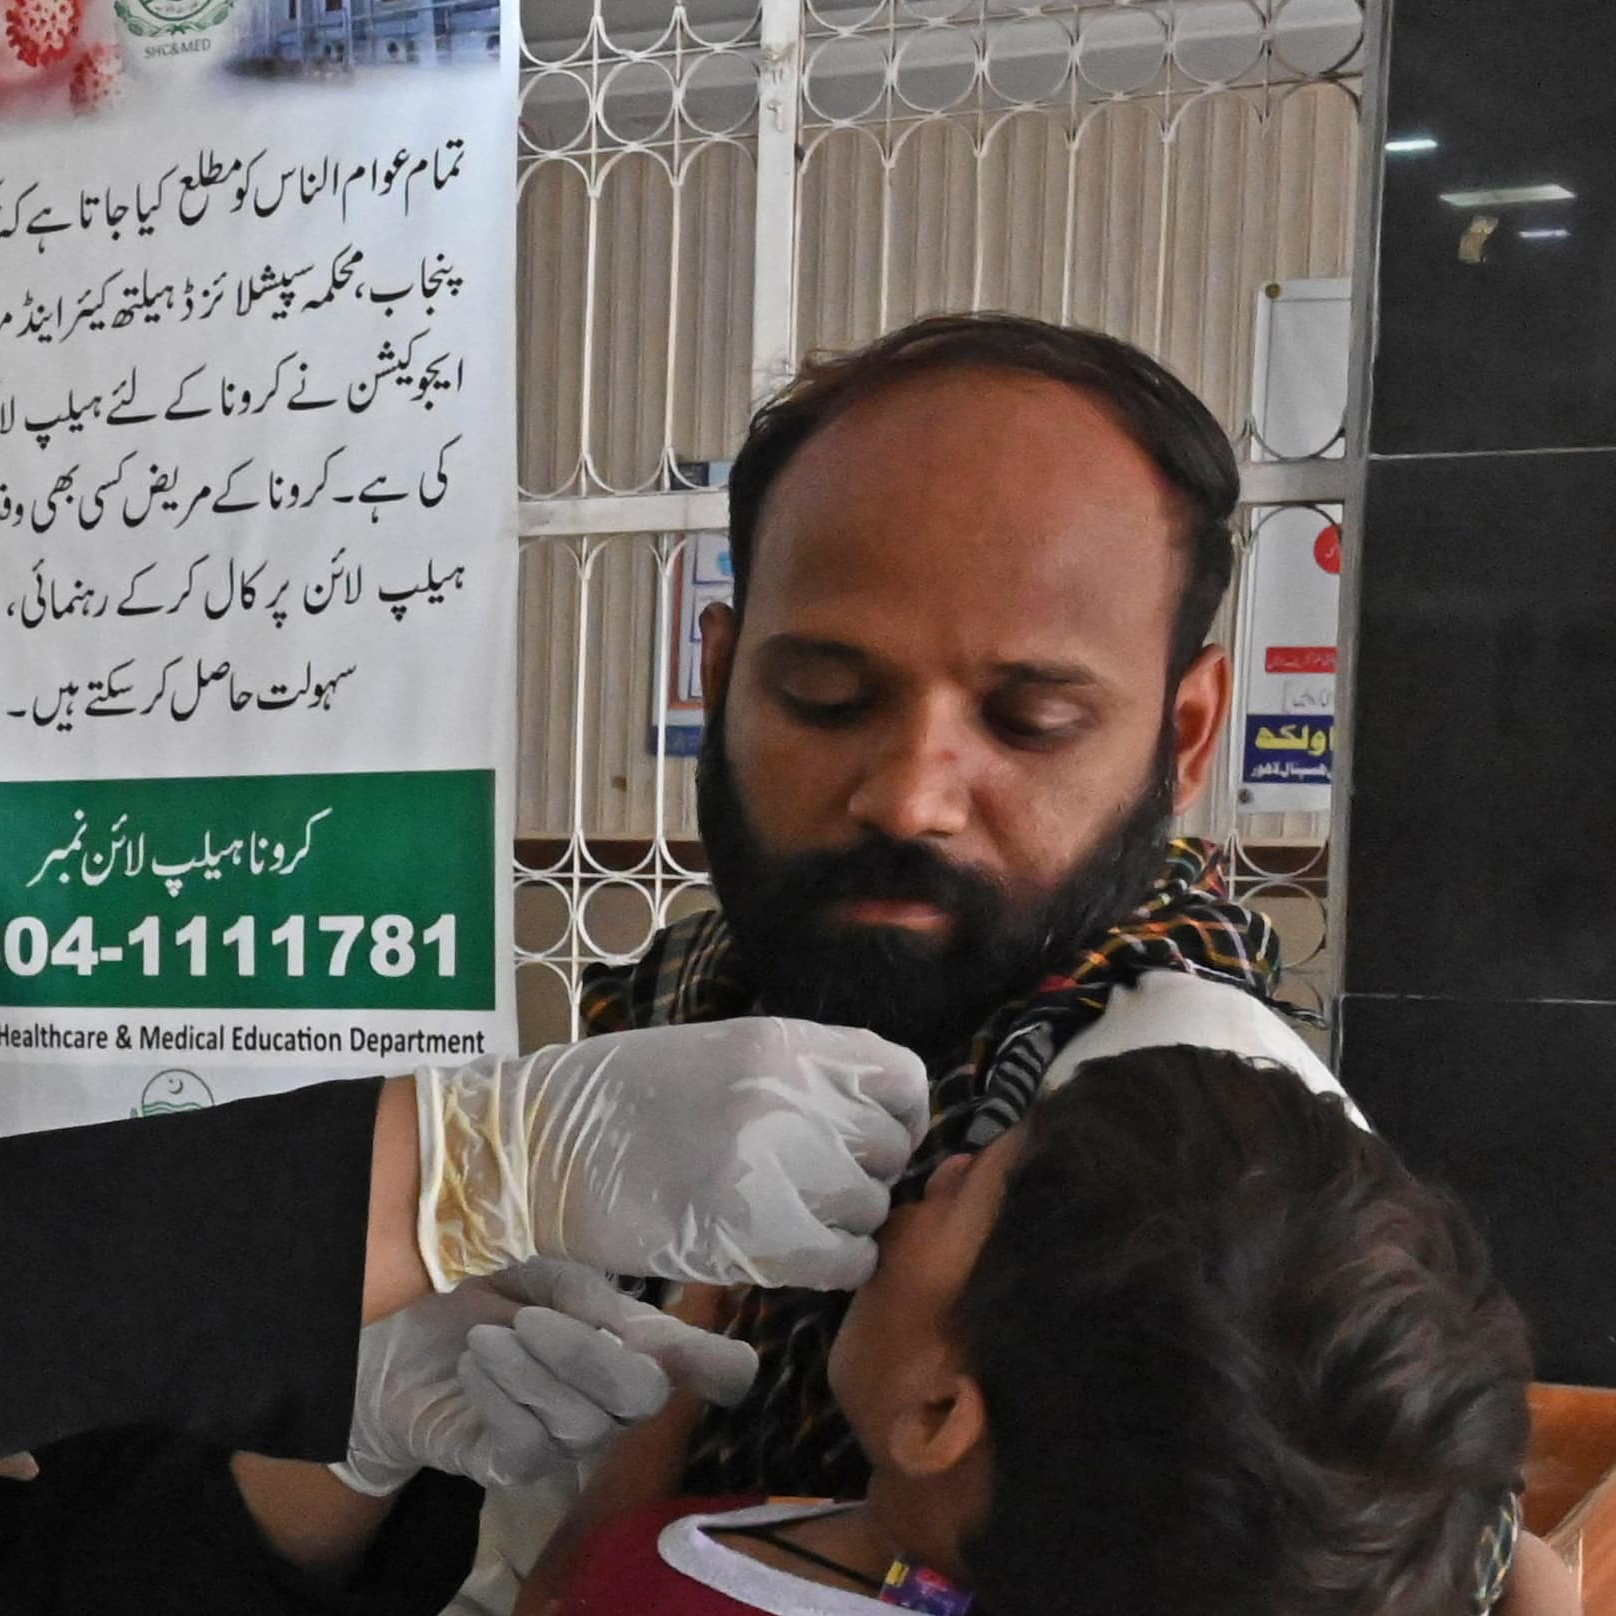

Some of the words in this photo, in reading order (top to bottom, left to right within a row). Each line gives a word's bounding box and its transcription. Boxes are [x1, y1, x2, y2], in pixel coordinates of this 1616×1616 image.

[144, 39, 212, 58] SHC&MED
[136, 164, 179, 236] کیا
[178, 150, 242, 227] مطلع
[229, 148, 268, 214] کو
[254, 155, 340, 218] الناس
[341, 148, 410, 224] عوام
[405, 138, 465, 218] تمام
[25, 207, 72, 255] ہے
[79, 187, 130, 241] جاتا
[59, 268, 124, 343] کیئر
[110, 268, 175, 329] ہیلتھ
[179, 263, 315, 322] سپیشلائزڈ
[301, 243, 364, 313] محکمہ
[17, 289, 63, 343] اینڈ
[106, 366, 158, 425] لئے
[165, 363, 213, 421] کے
[220, 351, 298, 416] کرونا
[286, 362, 338, 411] نے
[346, 328, 464, 415] ایجوکیشن
[24, 388, 103, 450] ہیلپ
[30, 463, 80, 533] بھی
[78, 450, 138, 531] کسی
[122, 463, 212, 529] مریض
[212, 458, 260, 513] کے
[269, 445, 347, 509] کرونا
[418, 433, 463, 508] کی
[204, 555, 268, 620] کال
[264, 579, 290, 629] پر
[303, 546, 363, 615] لائن
[378, 557, 465, 622] ہیلپ
[84, 657, 137, 717] سکتے
[139, 655, 184, 716] کر
[170, 656, 254, 723] حاصل
[255, 660, 357, 712] سہولت
[24, 807, 89, 888] نمبر
[80, 812, 146, 887] لائن
[150, 830, 245, 898] ہیلپ
[248, 807, 334, 875] کرونا
[115, 1024, 134, 1050] &
[138, 1024, 226, 1052] Medical
[233, 1025, 343, 1053] Education
[350, 1025, 486, 1058] Department
